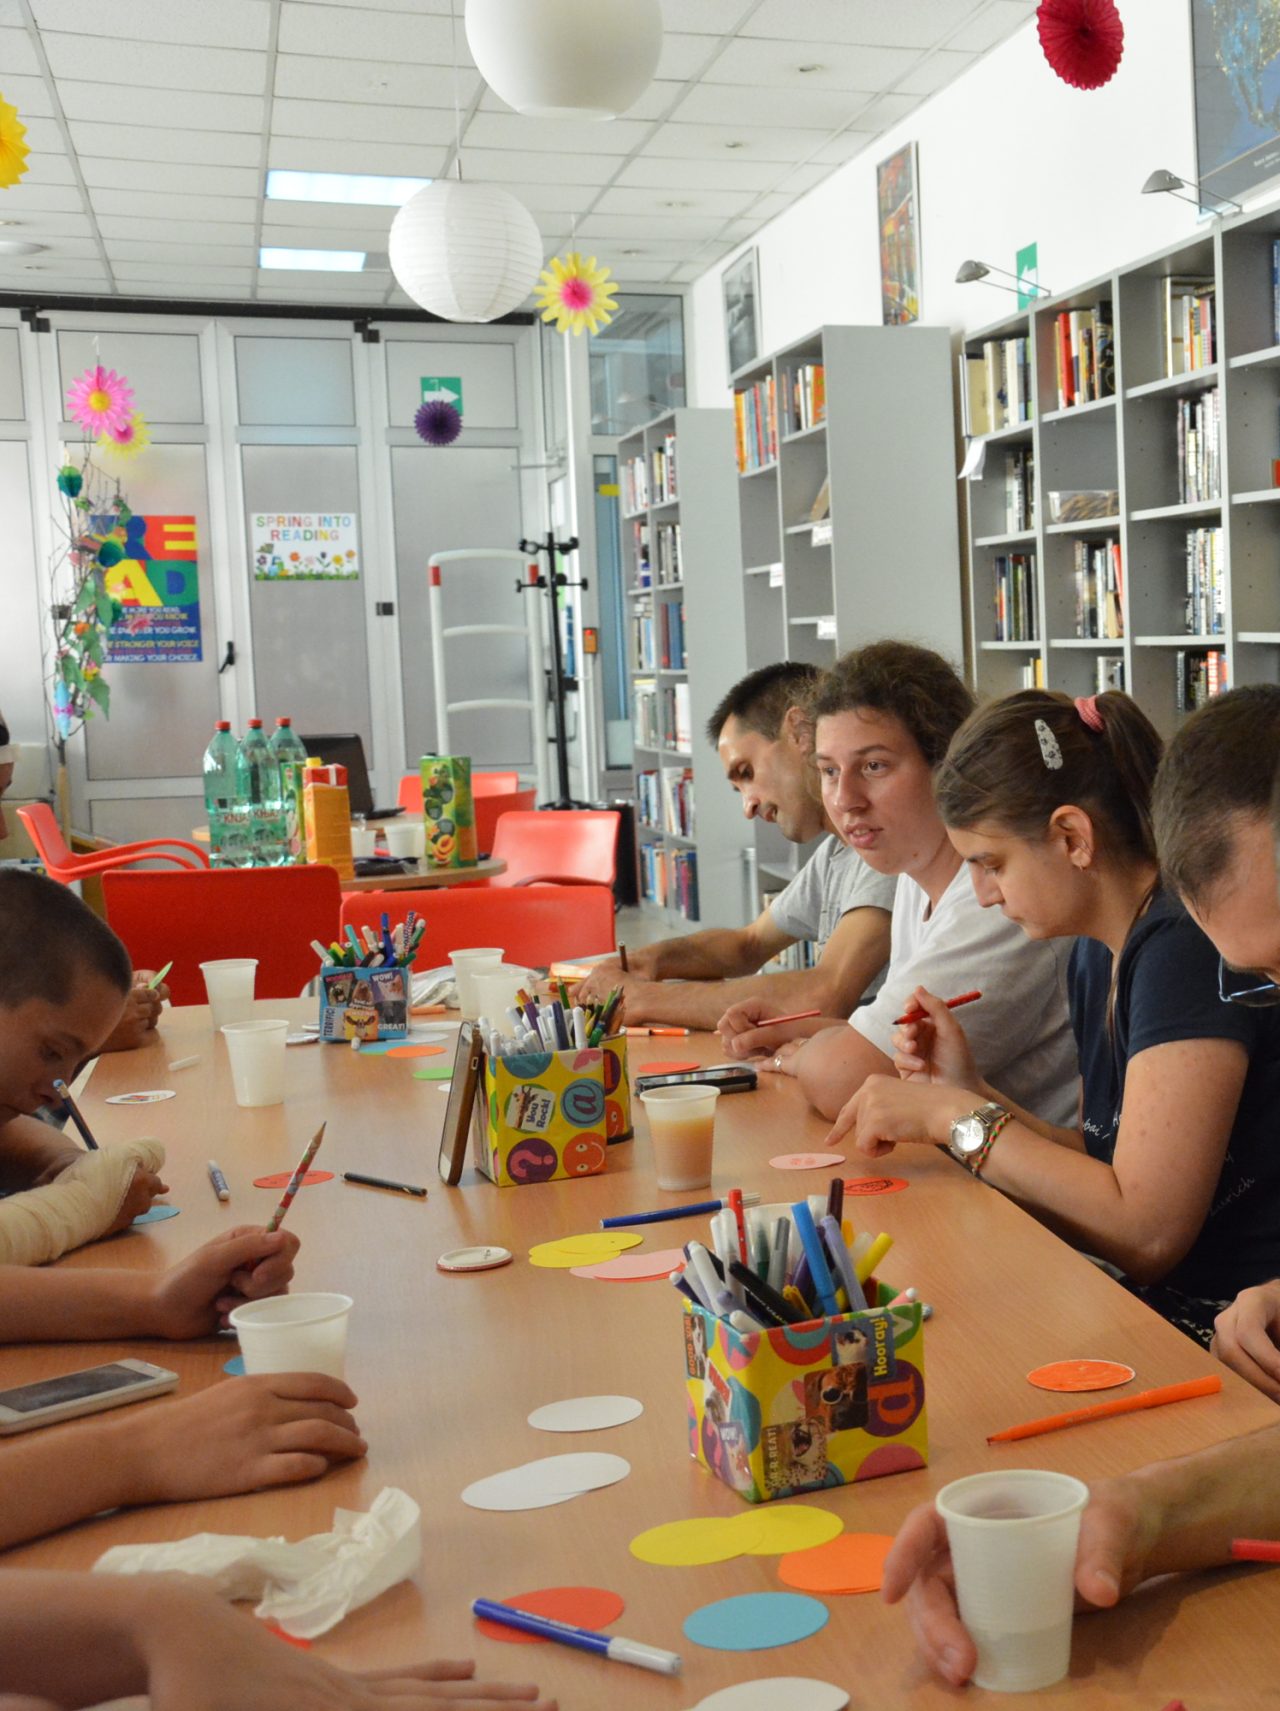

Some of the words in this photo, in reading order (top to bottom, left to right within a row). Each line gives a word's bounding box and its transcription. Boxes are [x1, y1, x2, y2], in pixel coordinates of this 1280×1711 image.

[256, 515, 313, 528] SPRING
[318, 515, 351, 528] INTO
[271, 529, 340, 542] READING
[115, 640, 155, 648] STRONGER
[157, 640, 177, 648] YOUR
[146, 654, 167, 662] YOUR
[371, 972, 394, 983] WOW!
[323, 1007, 336, 1038] TERRIFIC!
[377, 1022, 406, 1032] GREAT!
[525, 1100, 539, 1124] You
[535, 1098, 552, 1130] Rock!
[872, 1316, 889, 1377] Hooray!
[687, 1342, 697, 1376] GOOD
